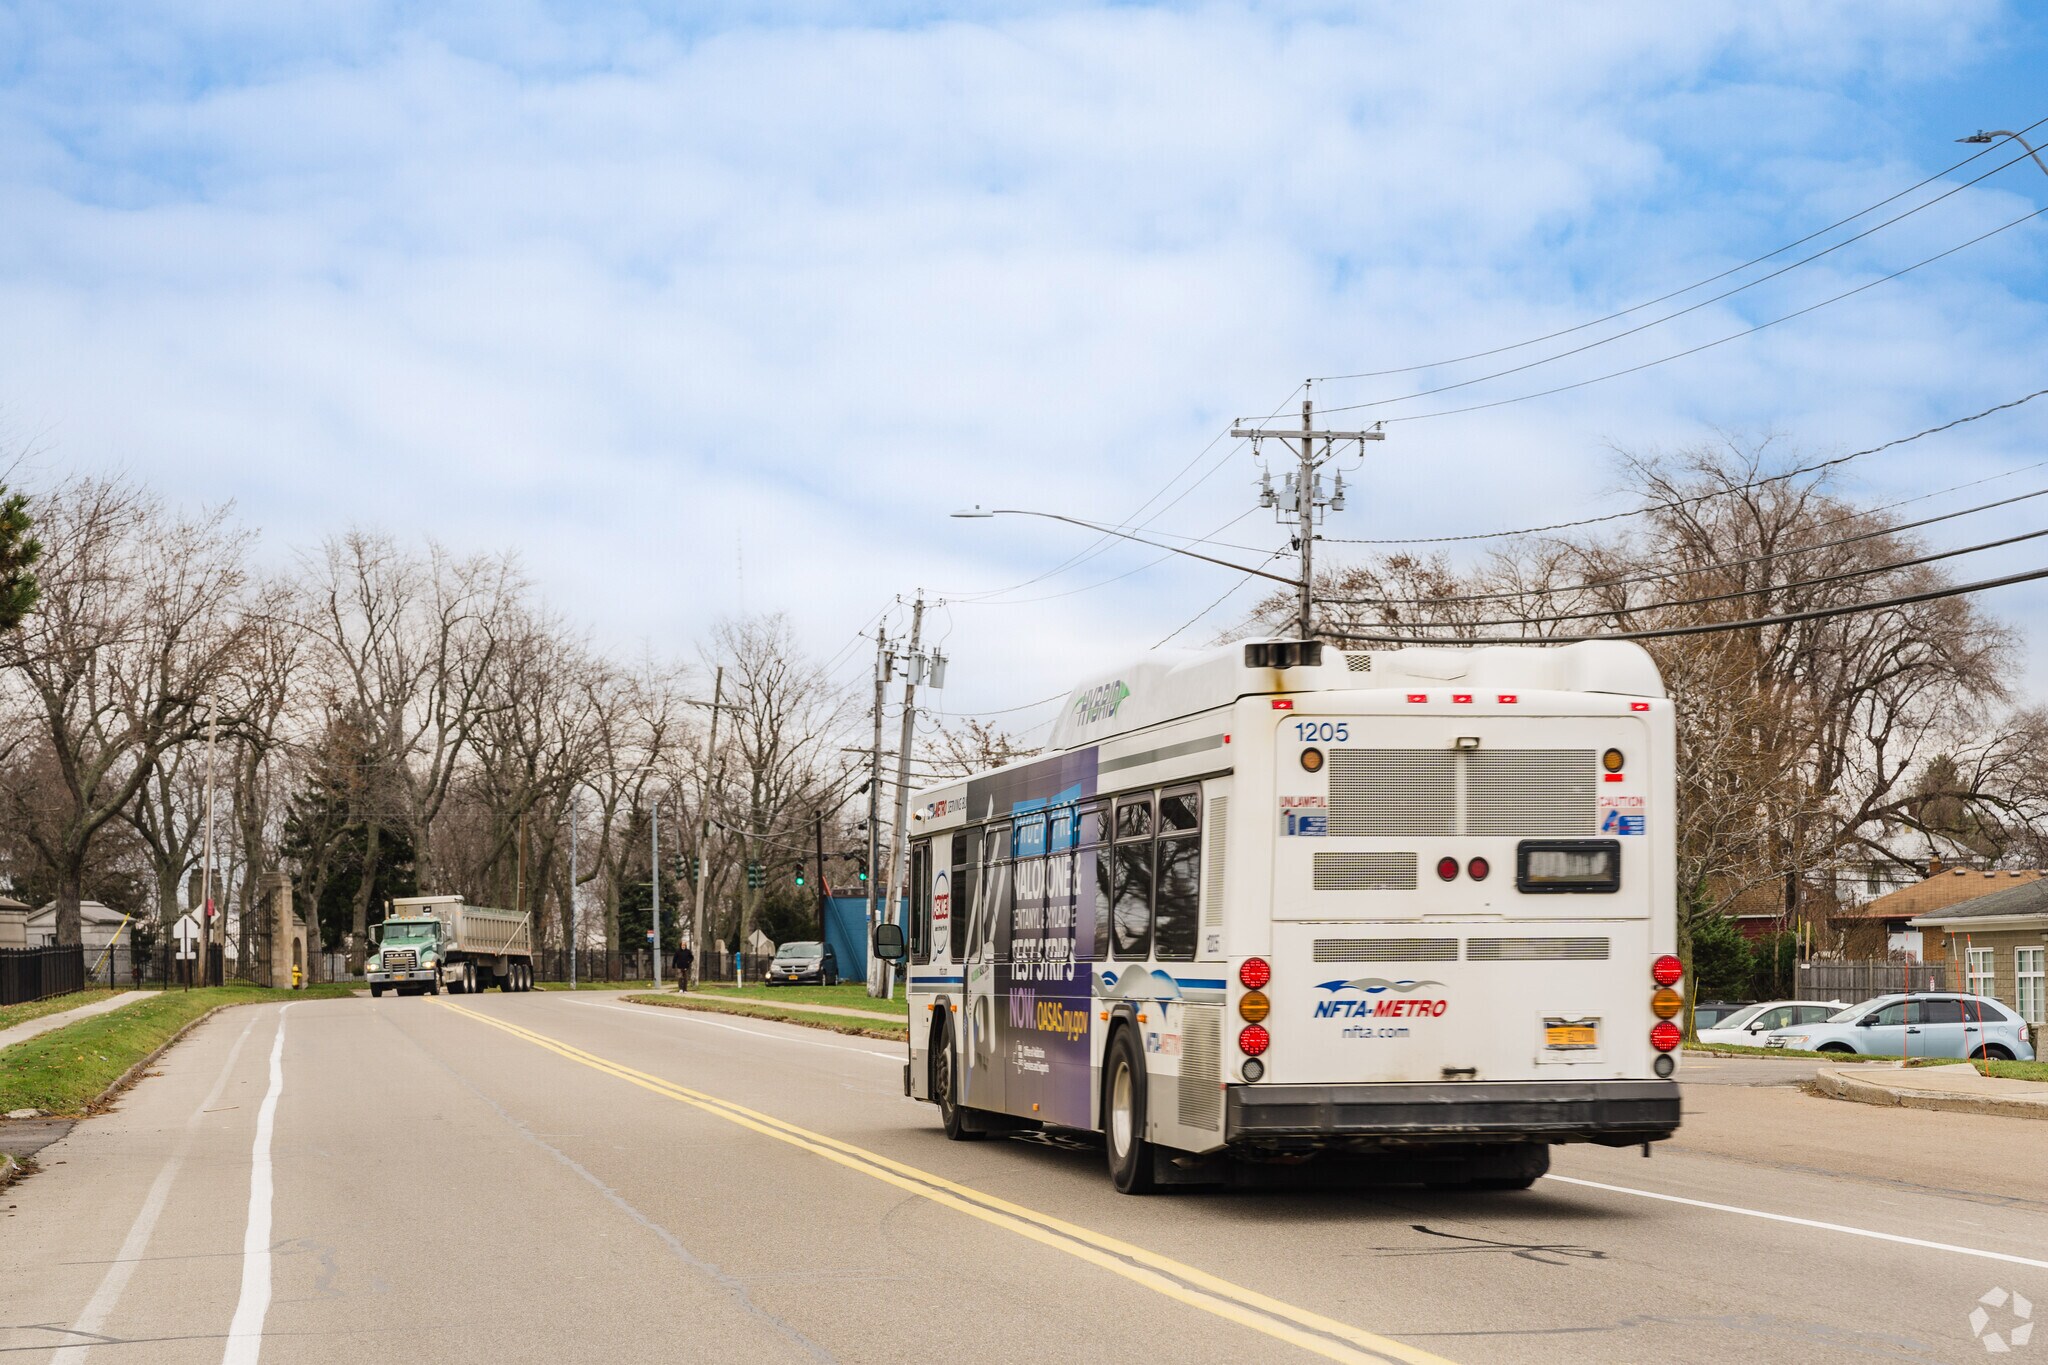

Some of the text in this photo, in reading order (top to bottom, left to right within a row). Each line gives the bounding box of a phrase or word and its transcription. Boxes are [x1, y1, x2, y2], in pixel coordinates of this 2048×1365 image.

[1077, 680, 1121, 727] HYBRID
[1295, 722, 1349, 742] 1205
[1600, 796, 1645, 807] CAUTION
[1013, 855, 1072, 900] NALOXONE
[1012, 907, 1041, 930] ENTANYL
[1011, 937, 1077, 981] TEST STRIPS
[1010, 988, 1036, 1030] NOW.
[1037, 1001, 1088, 1041] OASAS.ny.gov
[1314, 1000, 1447, 1018] NFTA-METRO
[1342, 1025, 1410, 1039] nfta.com
